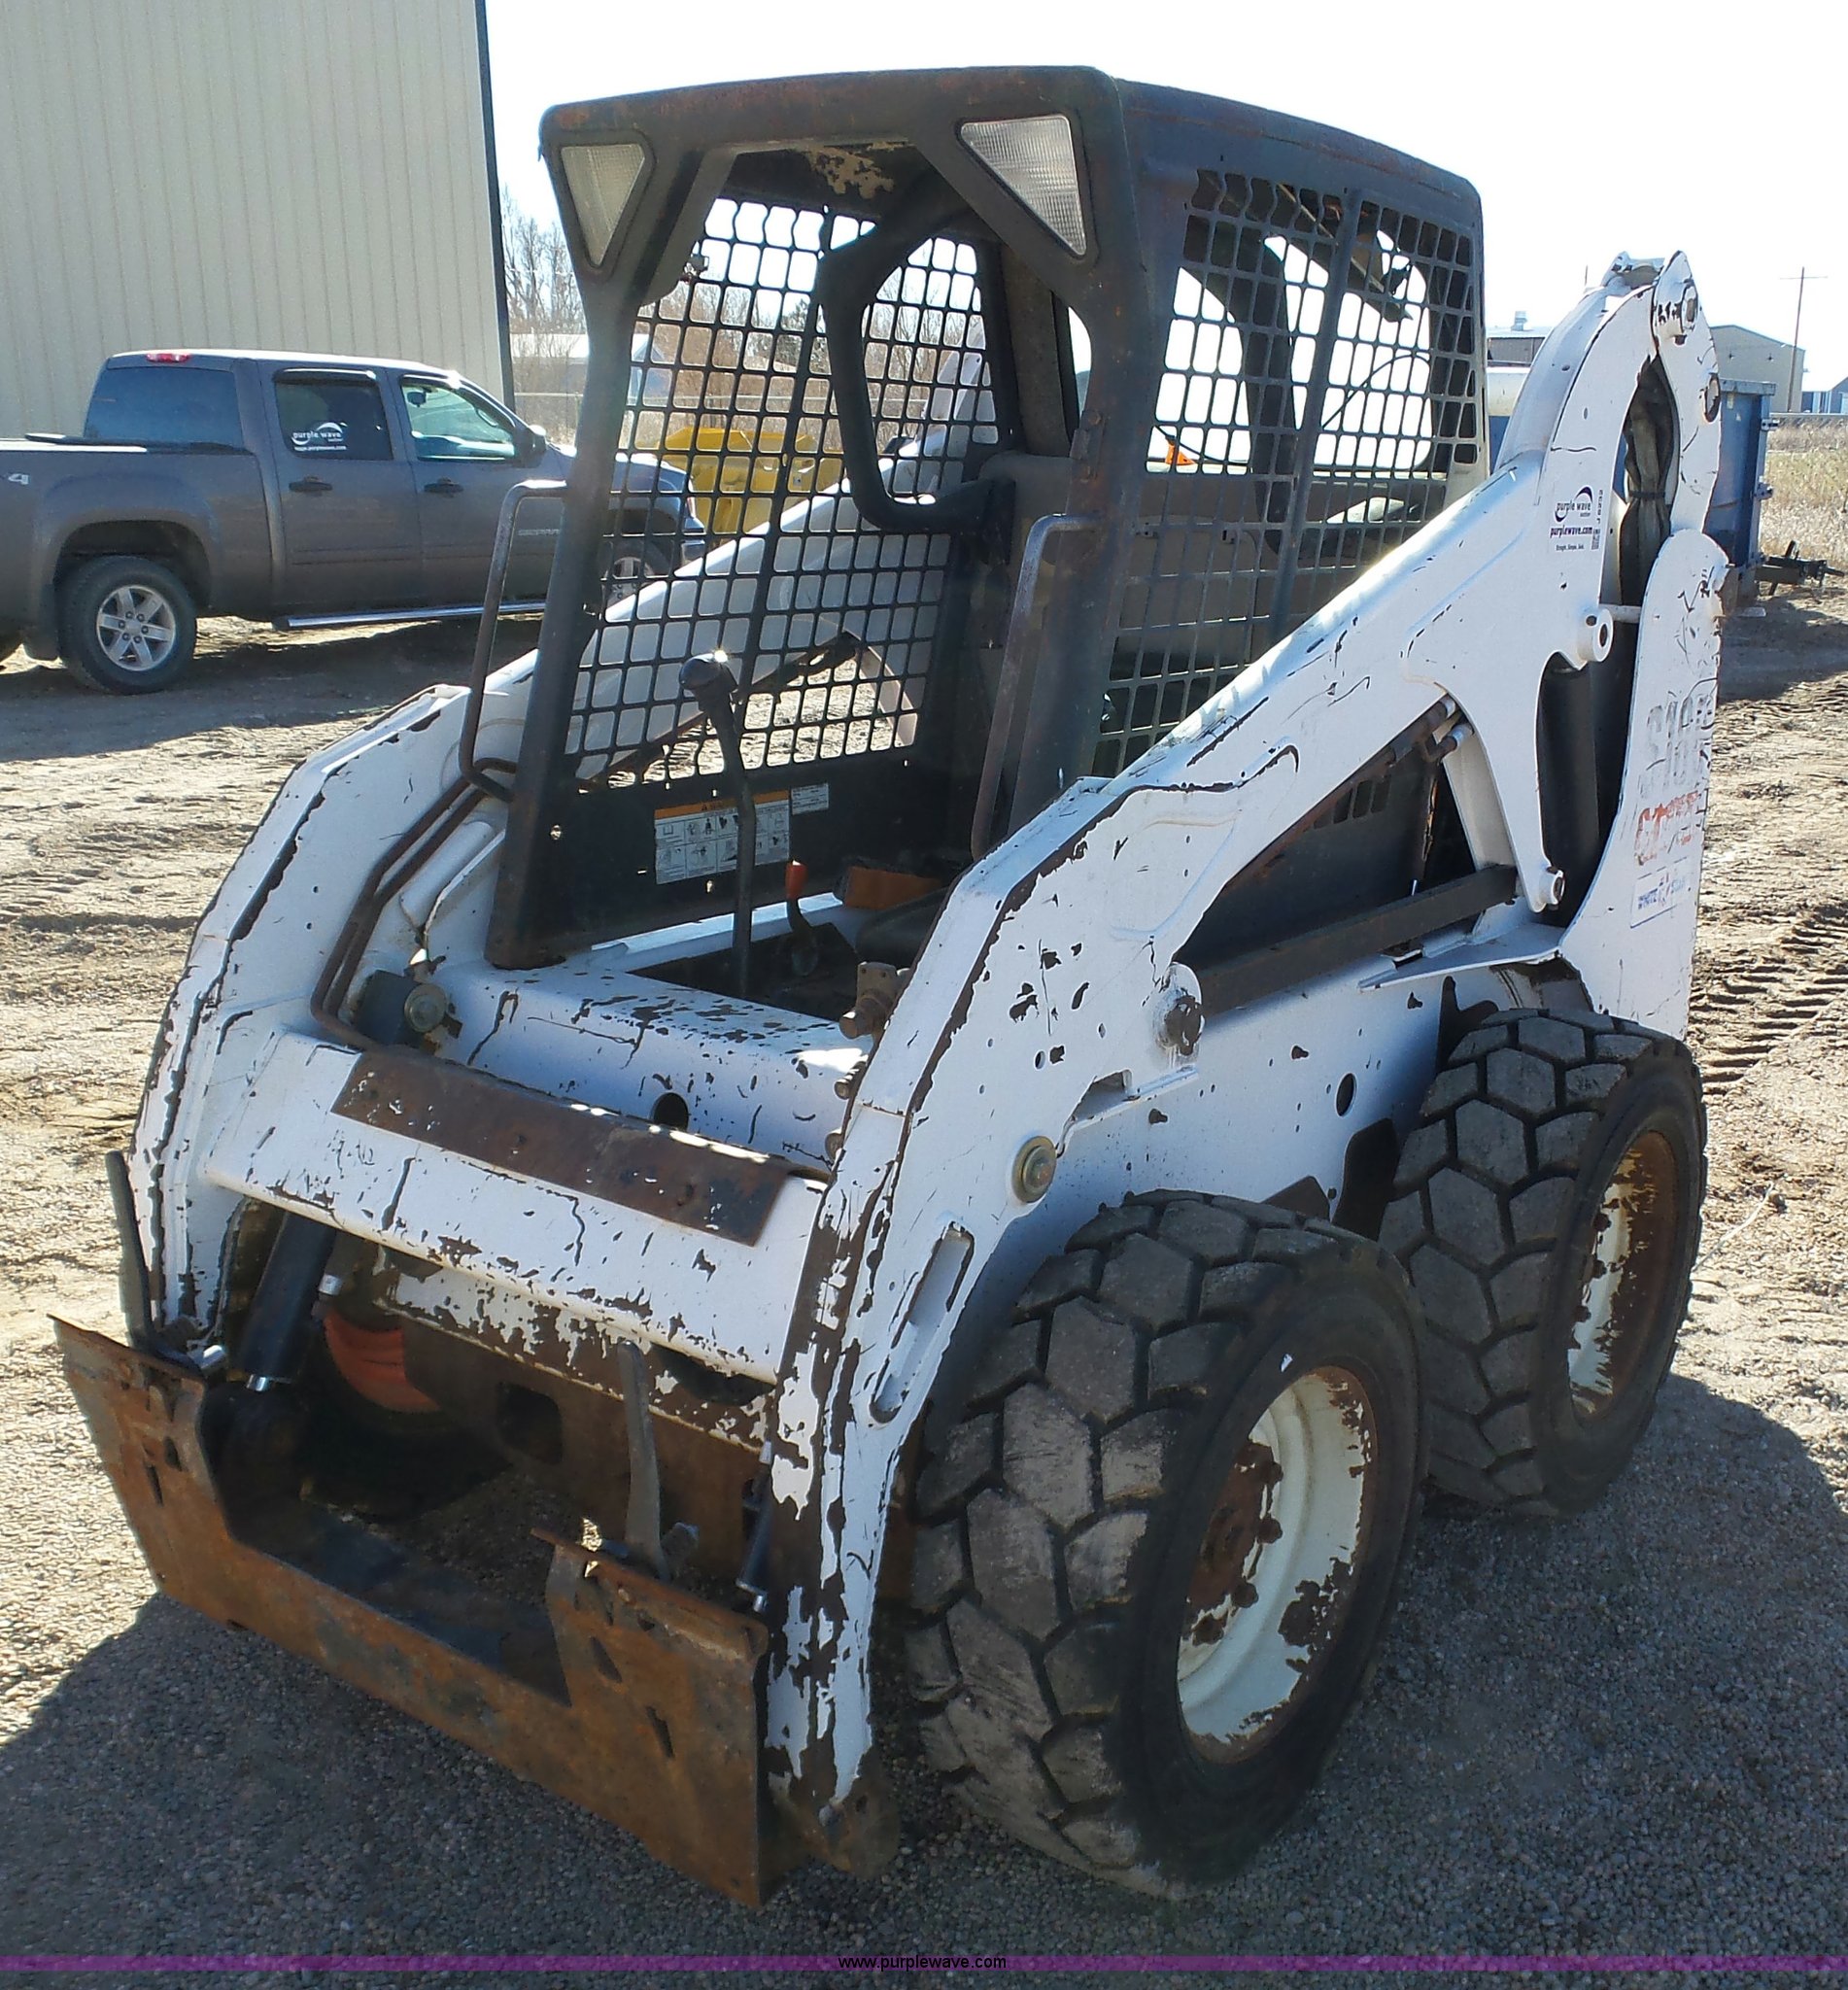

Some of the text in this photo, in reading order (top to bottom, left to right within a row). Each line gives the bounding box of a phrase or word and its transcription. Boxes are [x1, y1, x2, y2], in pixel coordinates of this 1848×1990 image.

[1557, 500, 1591, 512] purple wave
[1550, 525, 1593, 538] purplewave.com
